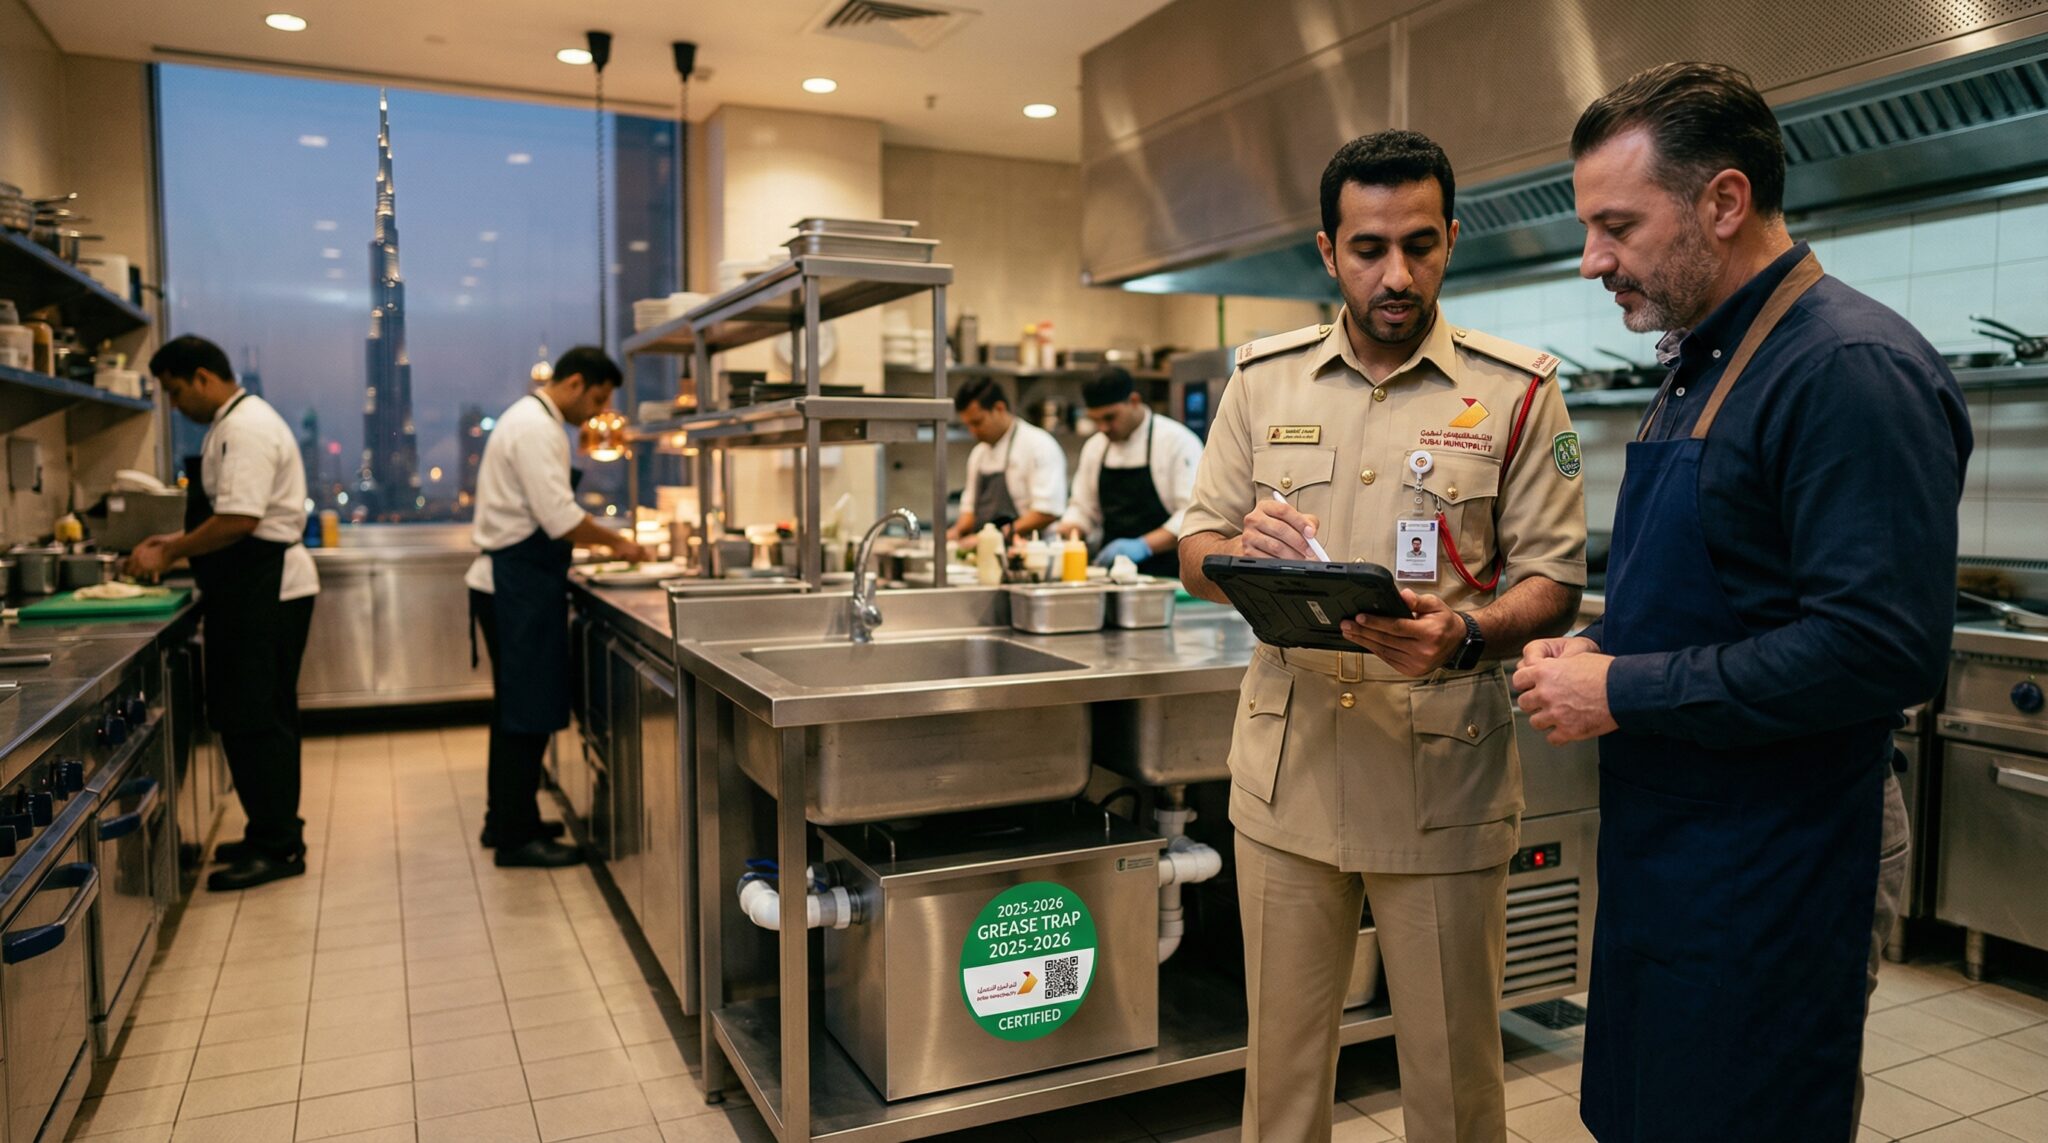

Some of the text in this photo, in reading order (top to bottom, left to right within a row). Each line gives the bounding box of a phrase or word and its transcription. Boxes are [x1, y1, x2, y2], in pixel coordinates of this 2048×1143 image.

[997, 896, 1064, 918] 2025-2026
[977, 911, 1081, 940] GREASE TRAP
[989, 932, 1071, 959] 2025-2026
[998, 1008, 1062, 1031] CERTIFIED
